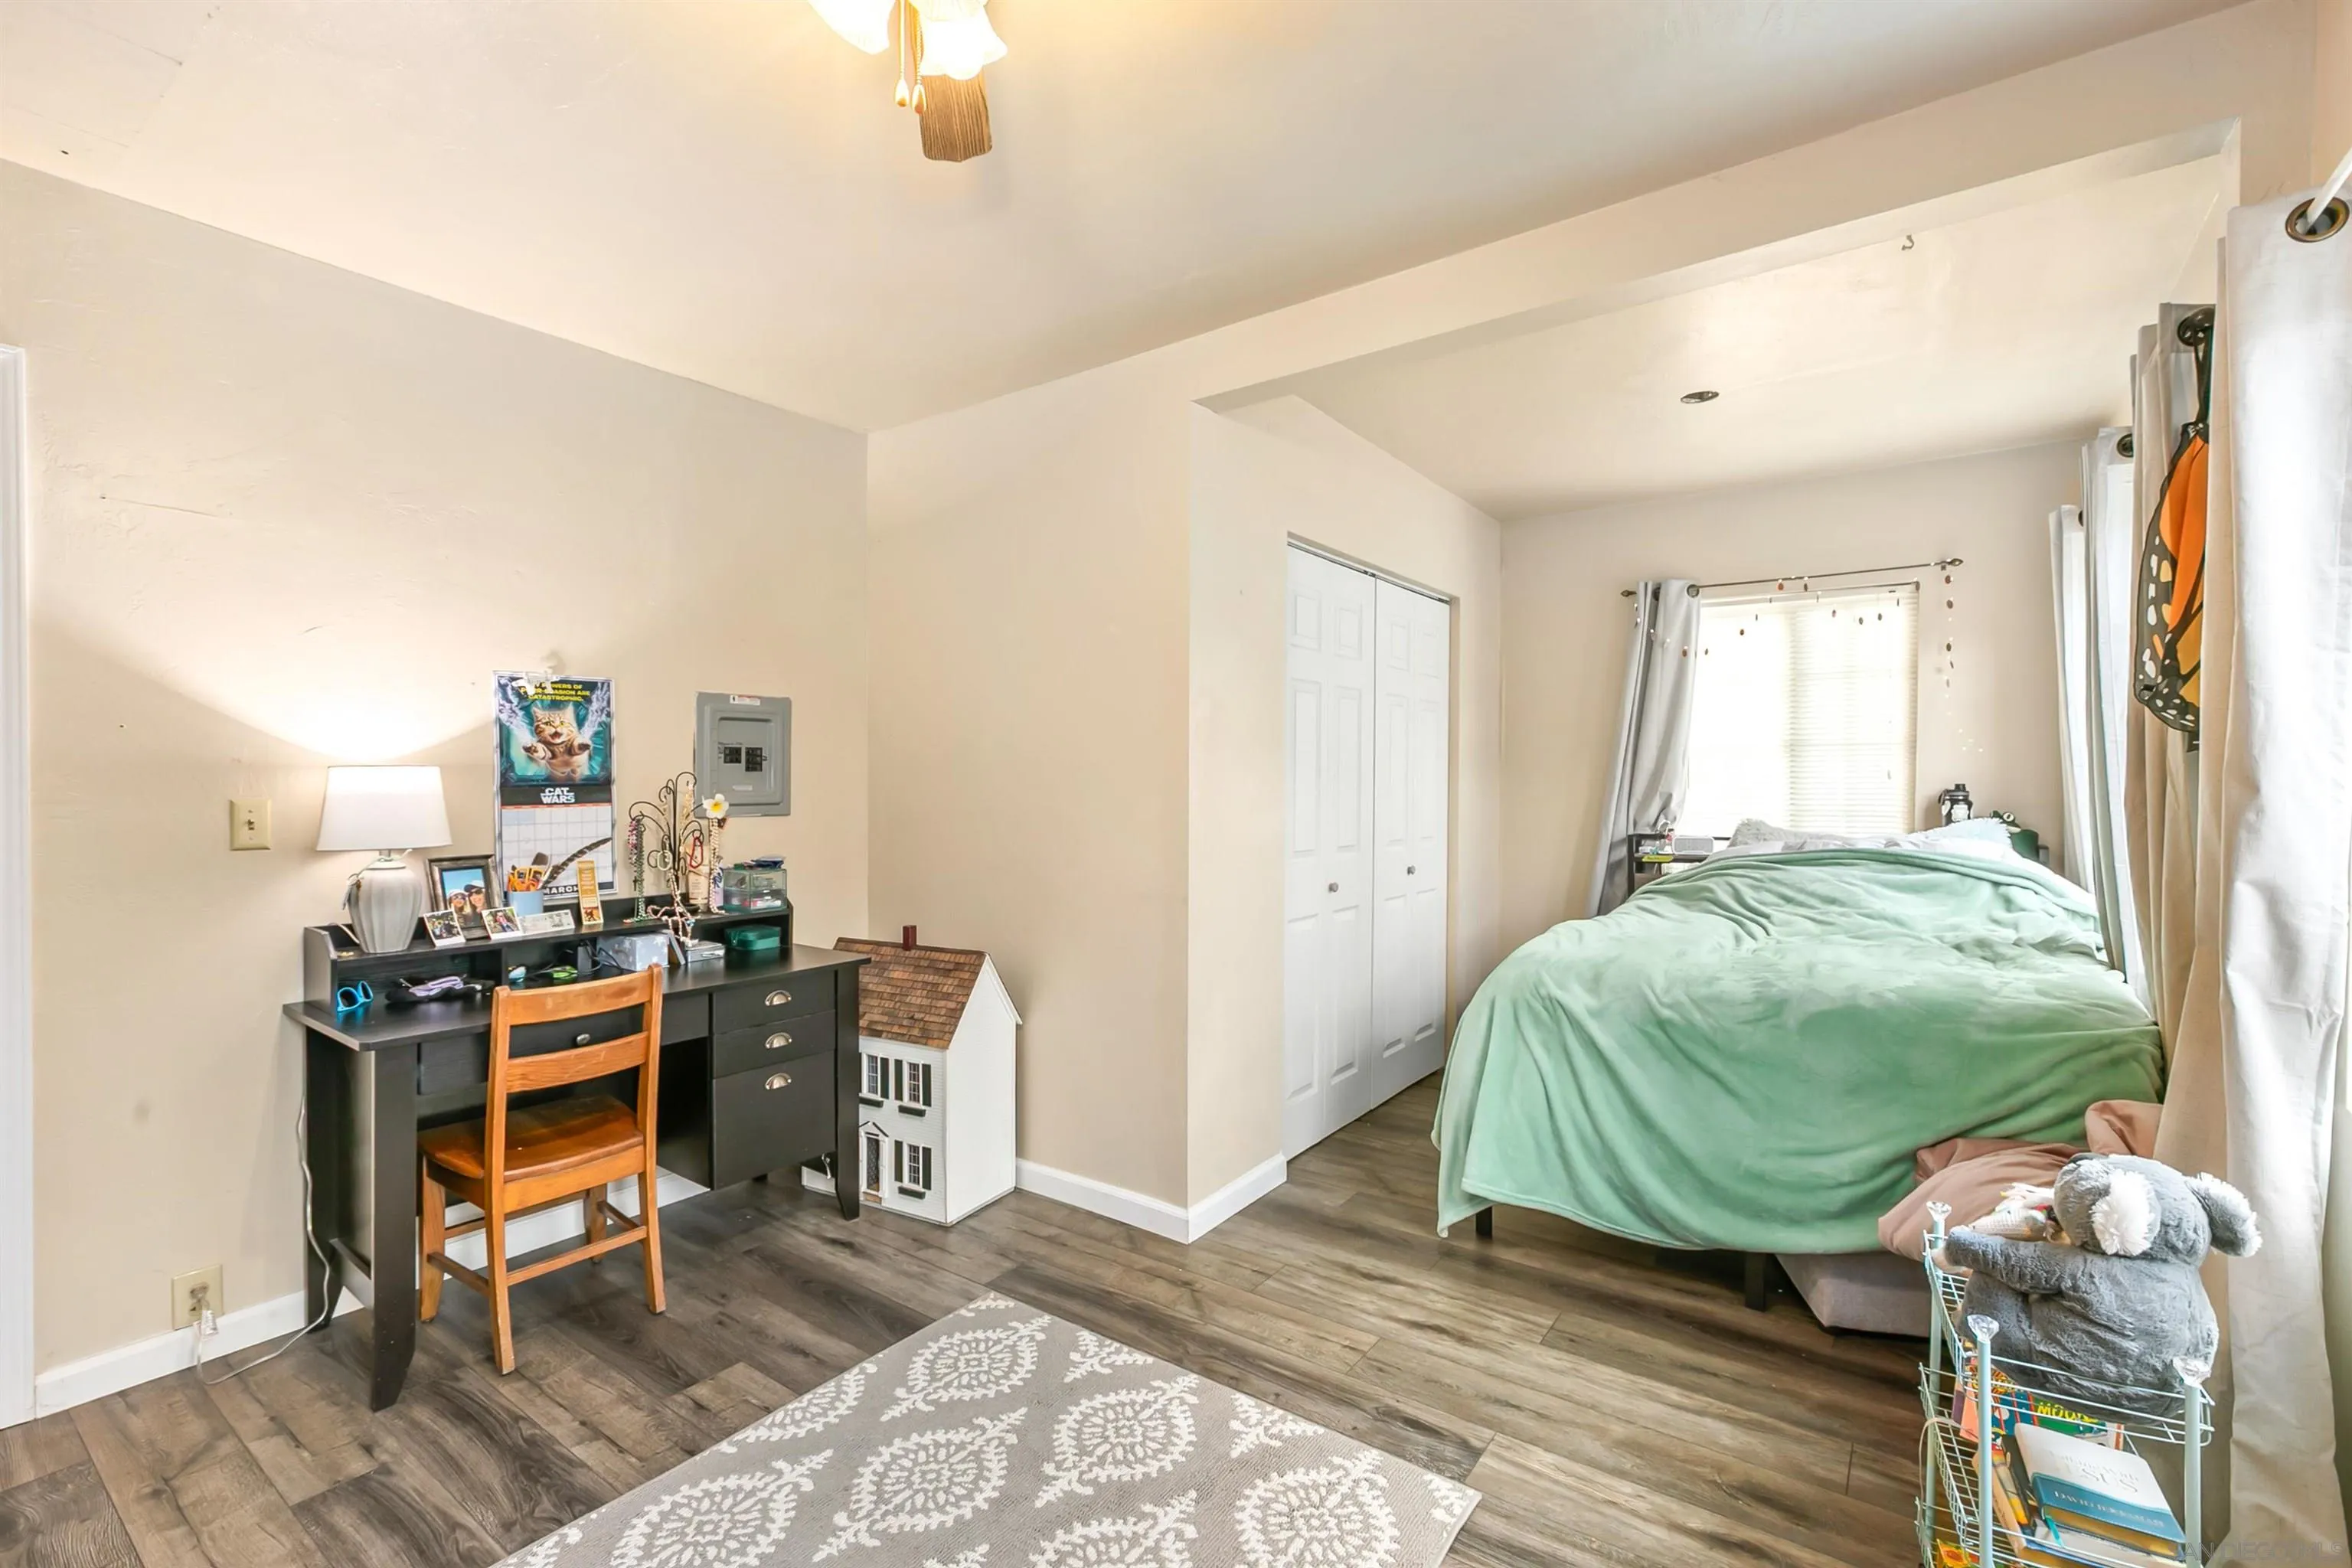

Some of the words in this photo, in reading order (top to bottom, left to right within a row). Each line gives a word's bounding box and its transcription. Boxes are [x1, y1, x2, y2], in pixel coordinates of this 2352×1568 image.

[540, 787, 574, 795] CAT
[541, 794, 575, 804] WARS
[544, 886, 579, 895] MARCH
